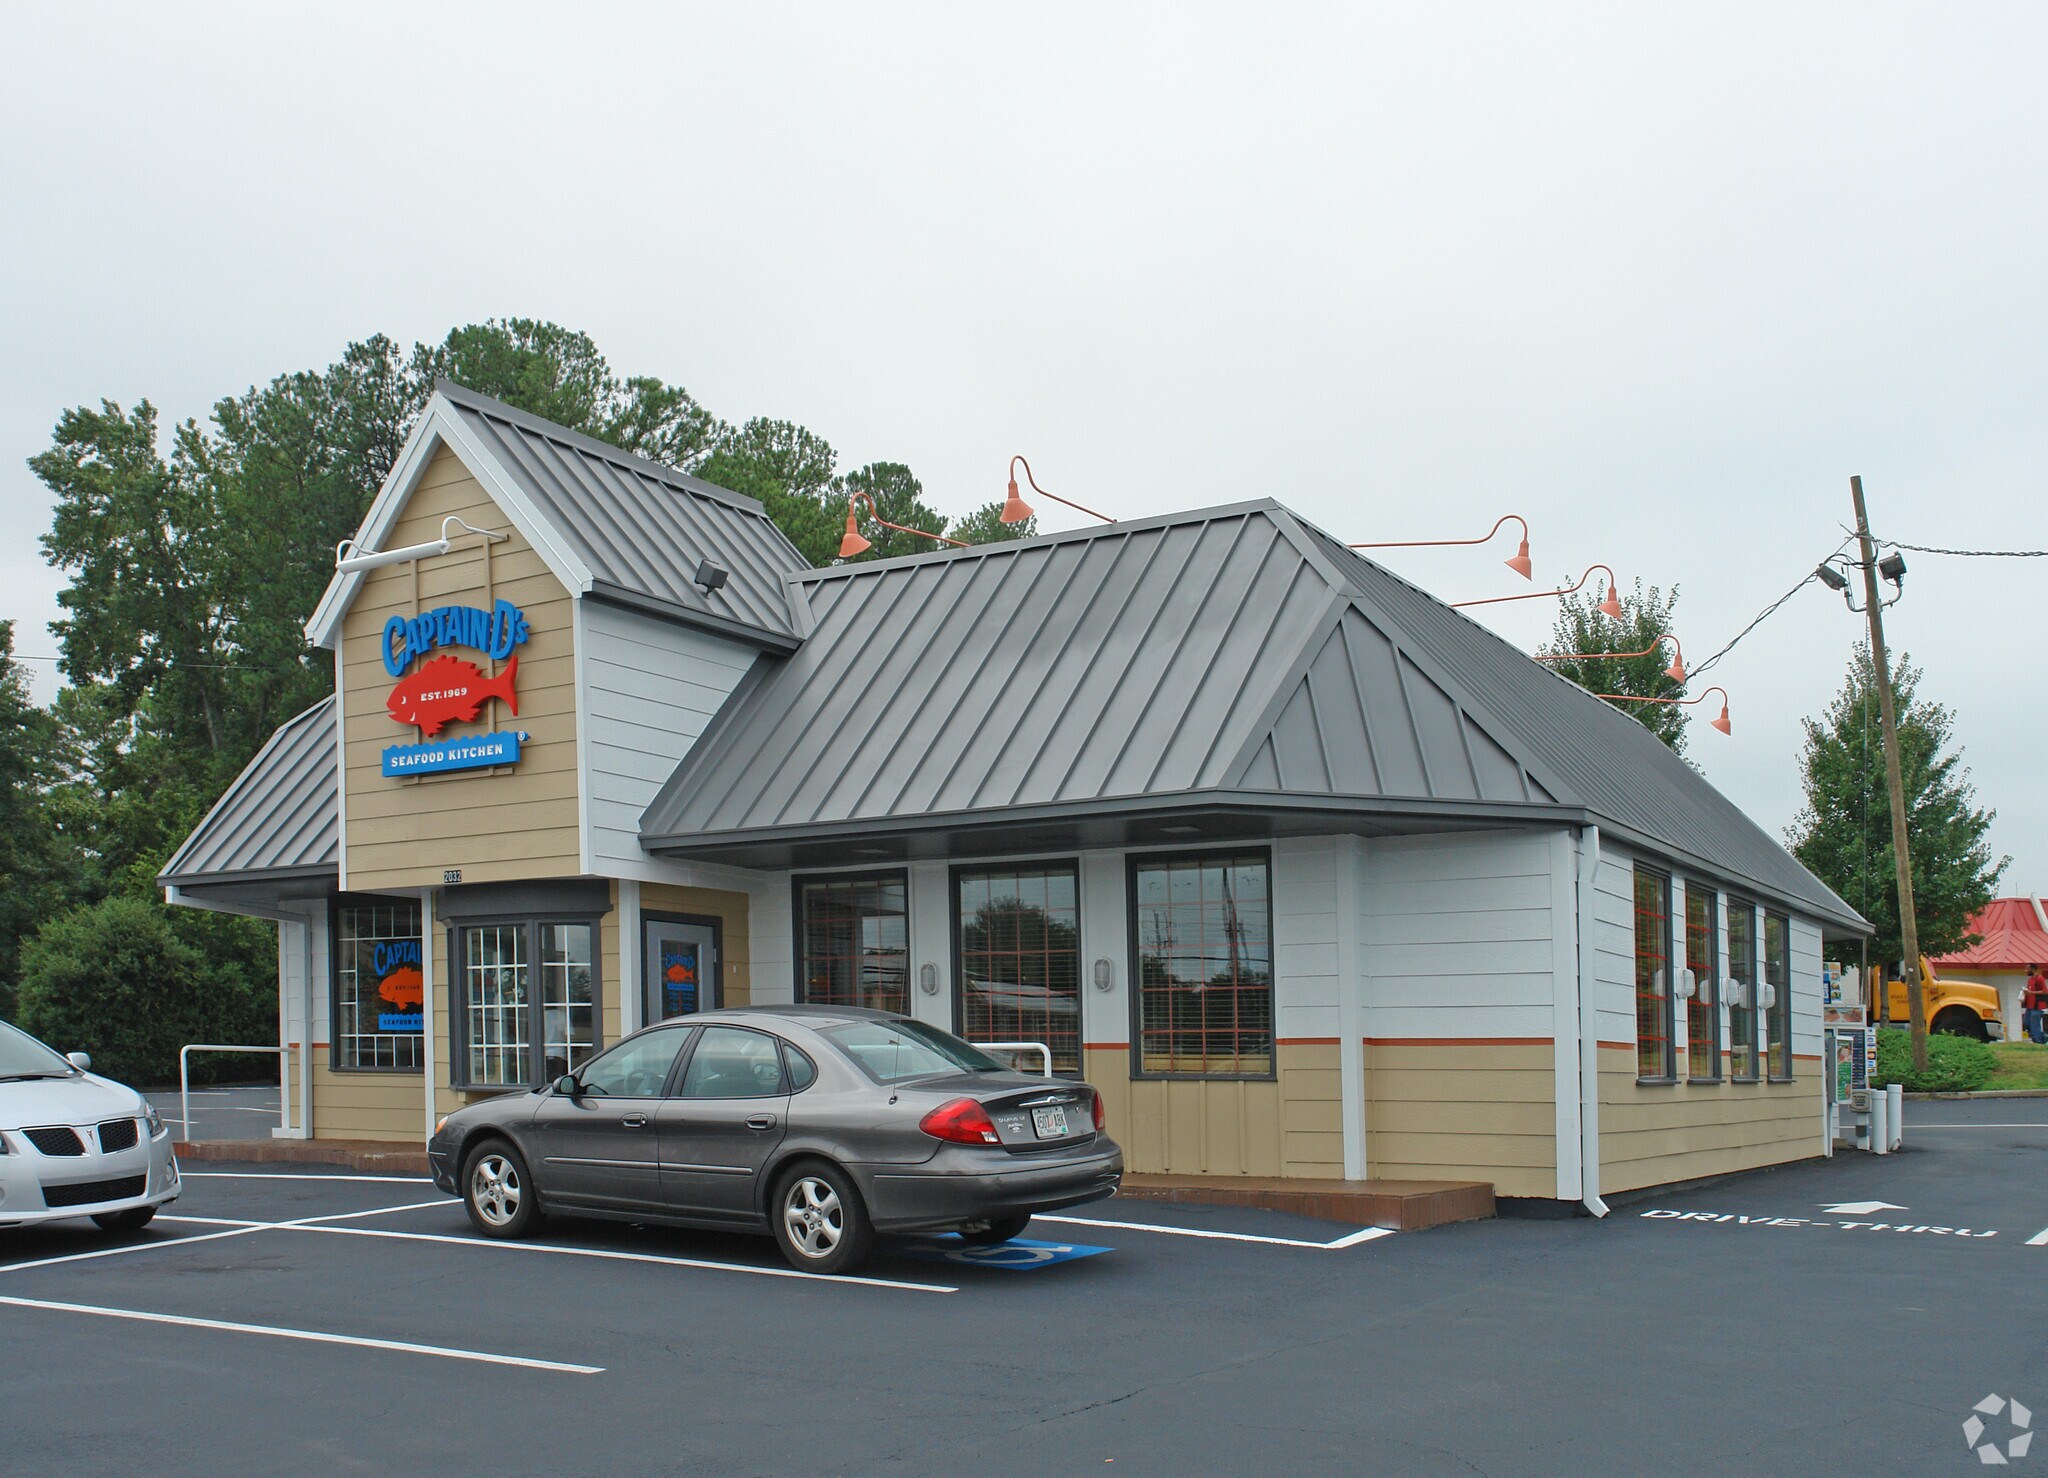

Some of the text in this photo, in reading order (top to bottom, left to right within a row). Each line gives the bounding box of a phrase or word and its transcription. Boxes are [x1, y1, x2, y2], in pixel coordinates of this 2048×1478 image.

[382, 606, 492, 677] CAPTAIN
[391, 744, 503, 768] SEAFOOD KITCHEN
[444, 871, 462, 882] 2032
[374, 941, 422, 976] CAPTAI
[1640, 1209, 1998, 1237] DRIVE-THRU
